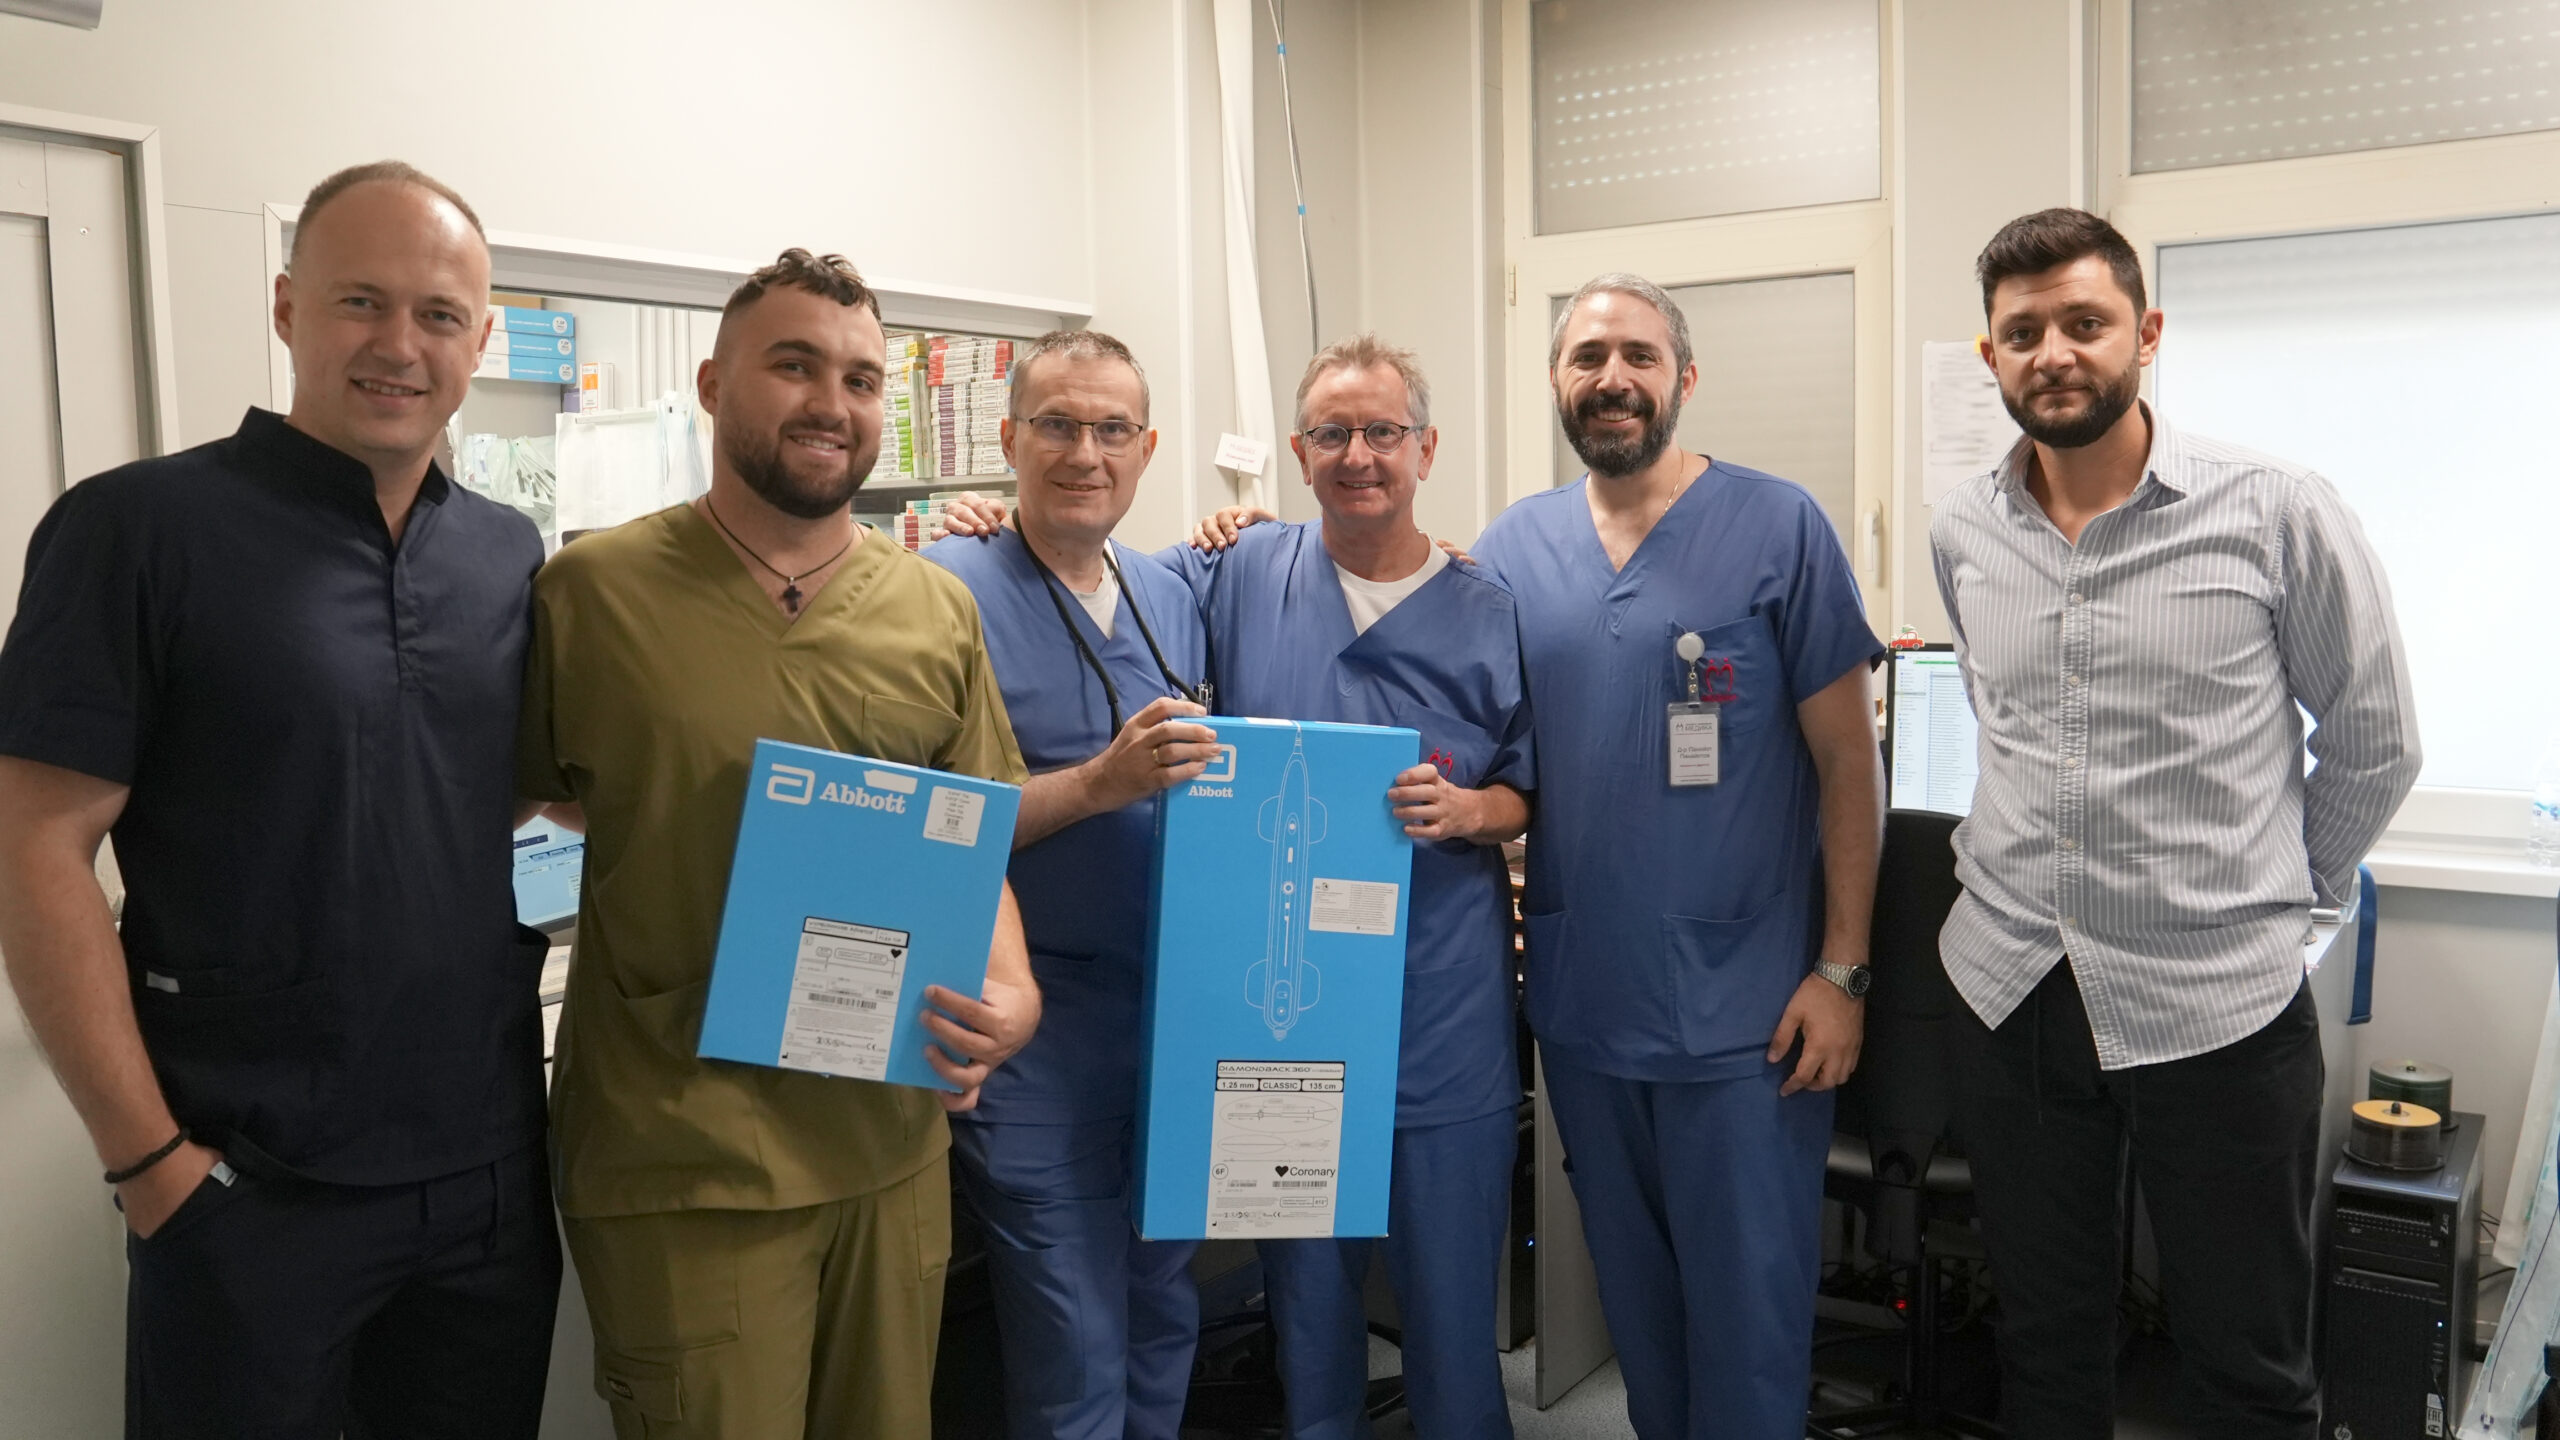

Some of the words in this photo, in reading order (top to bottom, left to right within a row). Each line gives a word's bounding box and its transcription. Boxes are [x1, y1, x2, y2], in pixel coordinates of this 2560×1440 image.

[1188, 785, 1234, 798] Abbott
[819, 781, 907, 815] Abbott
[1262, 1082, 1299, 1090] CLASSIC
[1309, 1082, 1323, 1090] 135
[1289, 1167, 1336, 1178] Coronary
